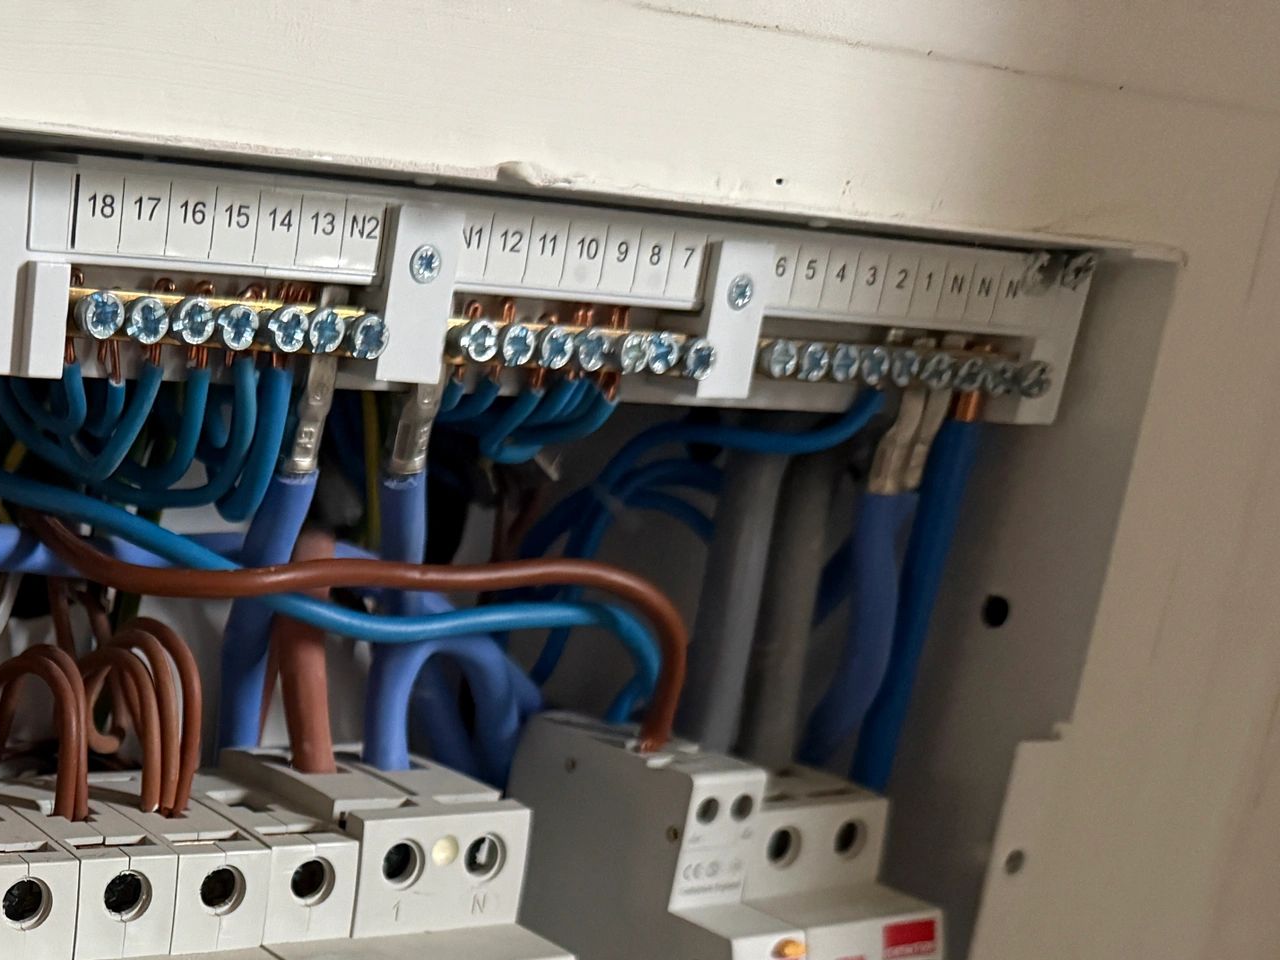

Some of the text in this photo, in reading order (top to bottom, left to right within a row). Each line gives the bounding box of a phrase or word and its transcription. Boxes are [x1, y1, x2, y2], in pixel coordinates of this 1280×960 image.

[88, 192, 379, 241] 18 17 16 15 14 13 N2
[500, 229, 524, 253] 12
[539, 233, 557, 257] 11
[577, 236, 598, 260] 10
[617, 241, 629, 262] 9
[649, 244, 661, 266] 8
[683, 247, 695, 269] 7
[775, 256, 1018, 299] 6 5 4 3 2 1 N N N
